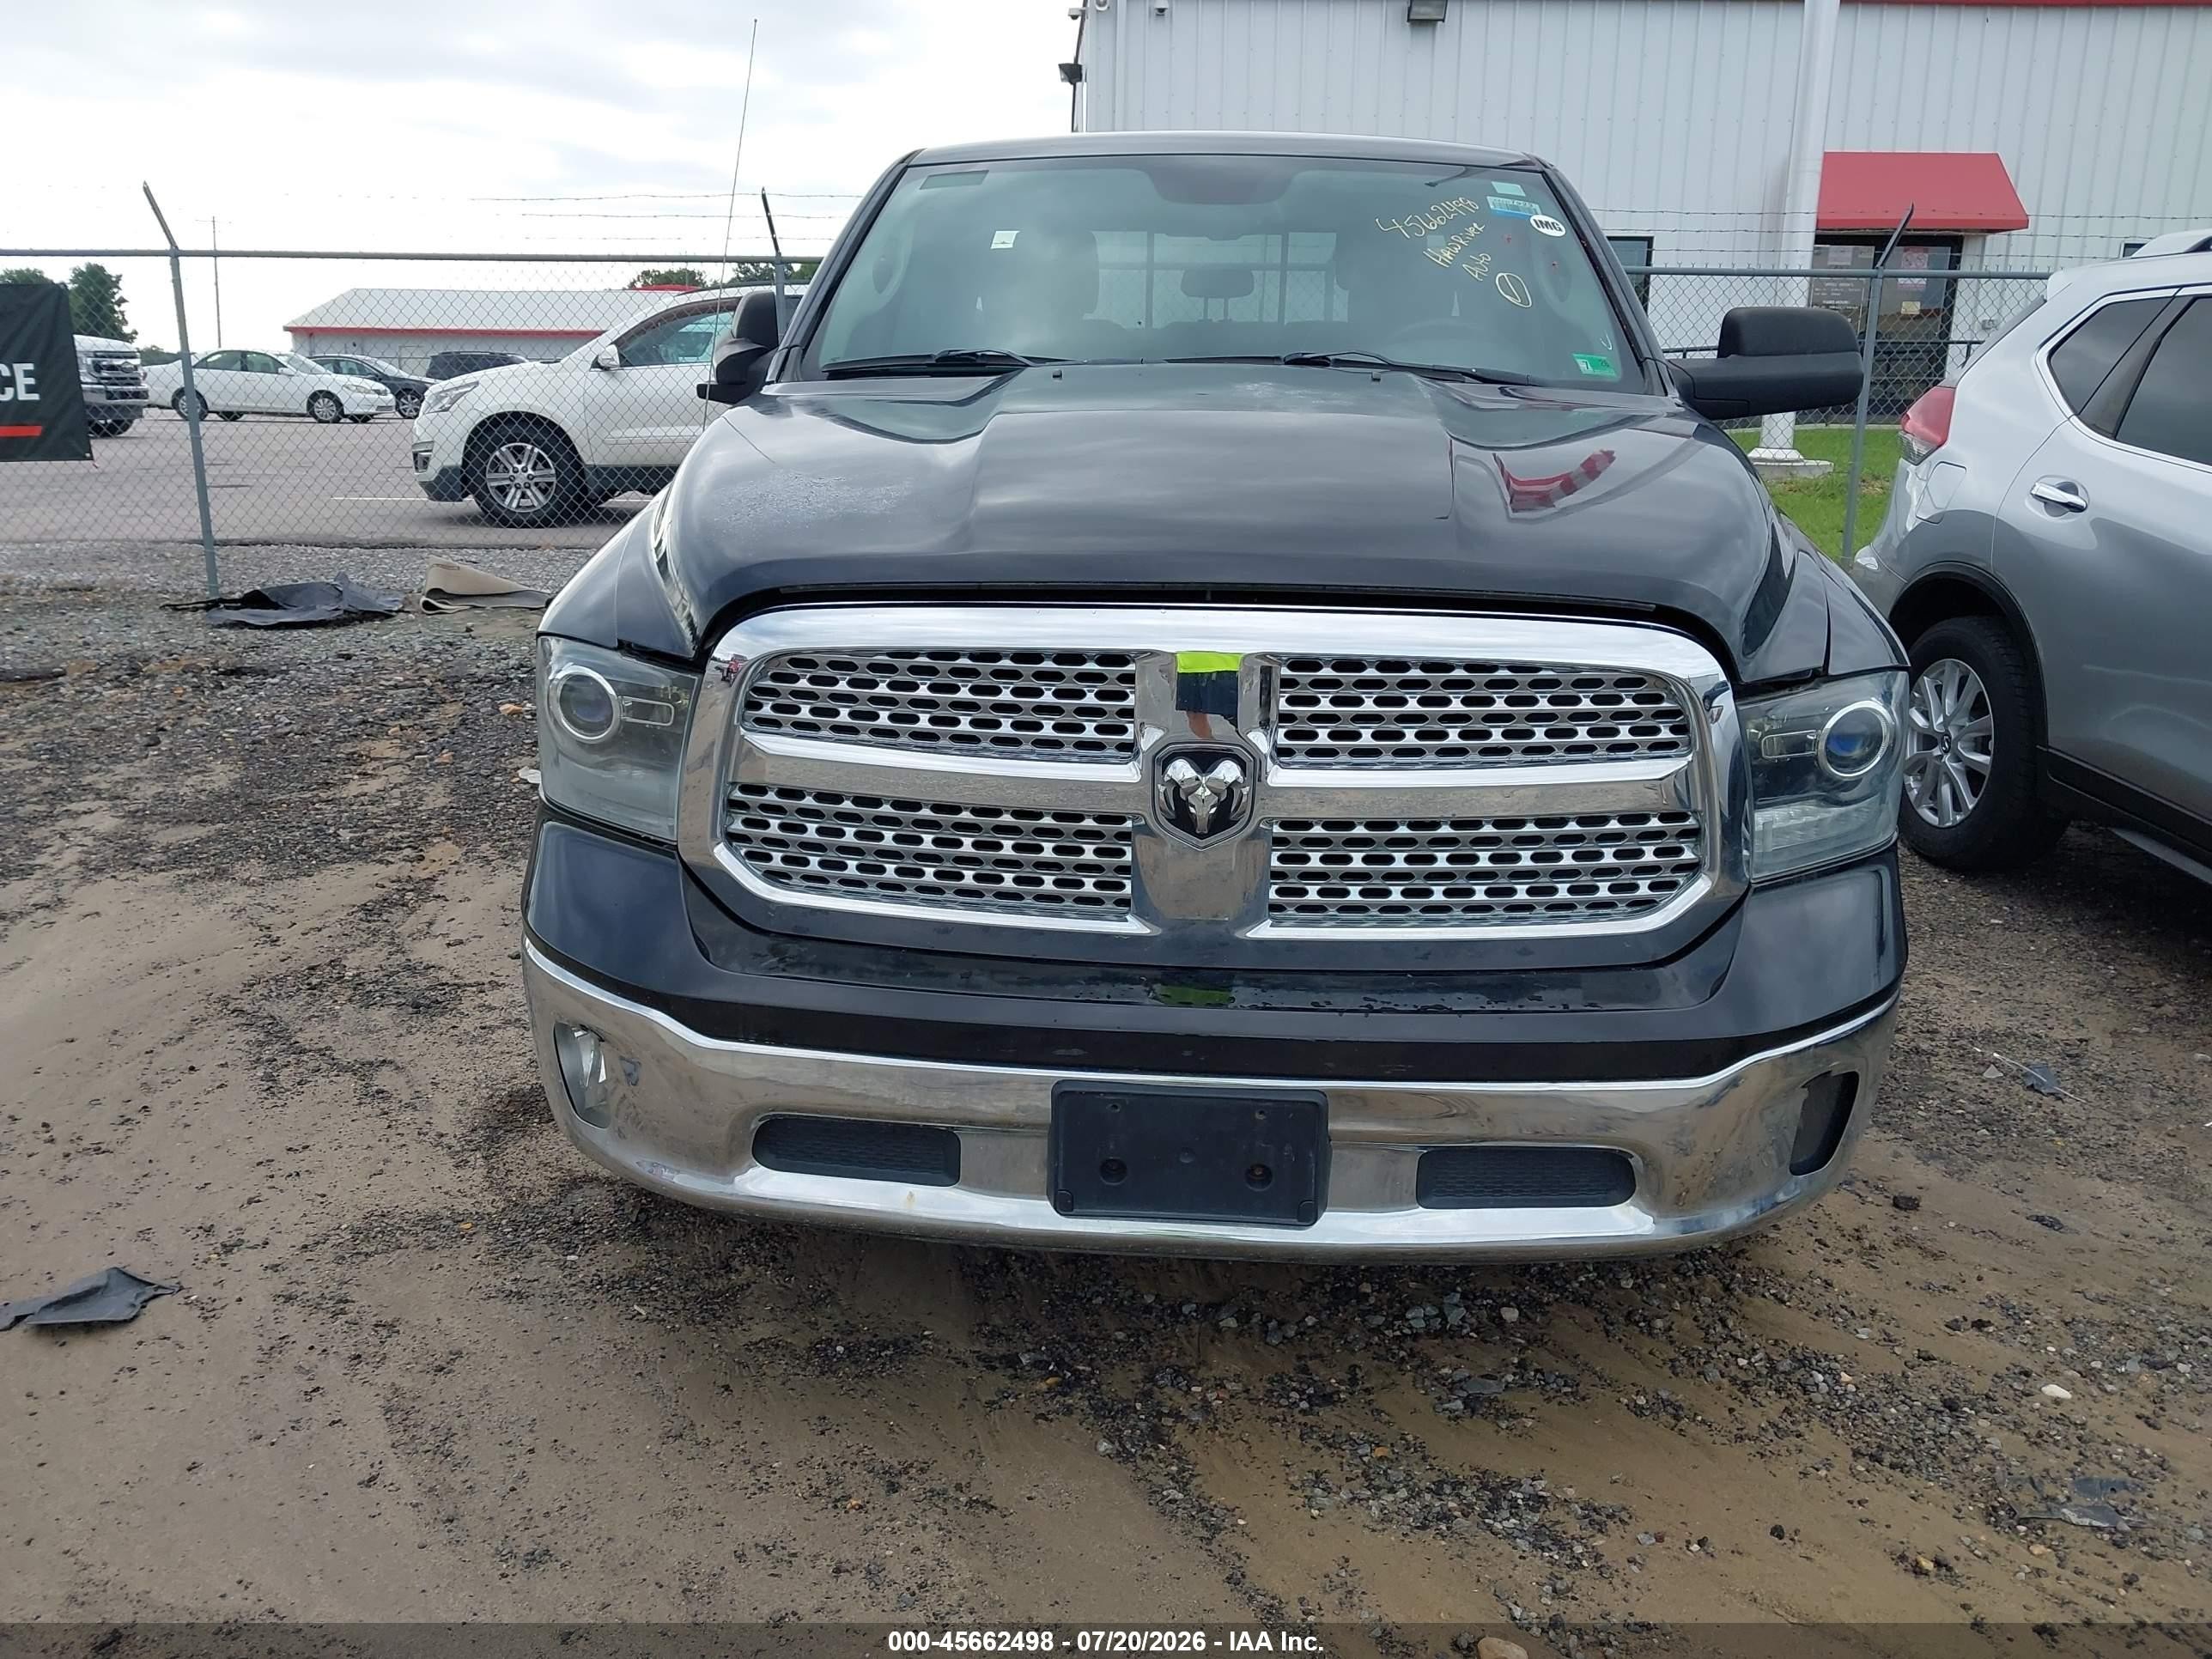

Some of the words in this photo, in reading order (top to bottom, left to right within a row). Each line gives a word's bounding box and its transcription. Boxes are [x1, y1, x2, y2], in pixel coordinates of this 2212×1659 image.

[1376, 197, 1479, 239] 45662498
[1533, 218, 1563, 233] IMG
[1462, 252, 1492, 281] Auto
